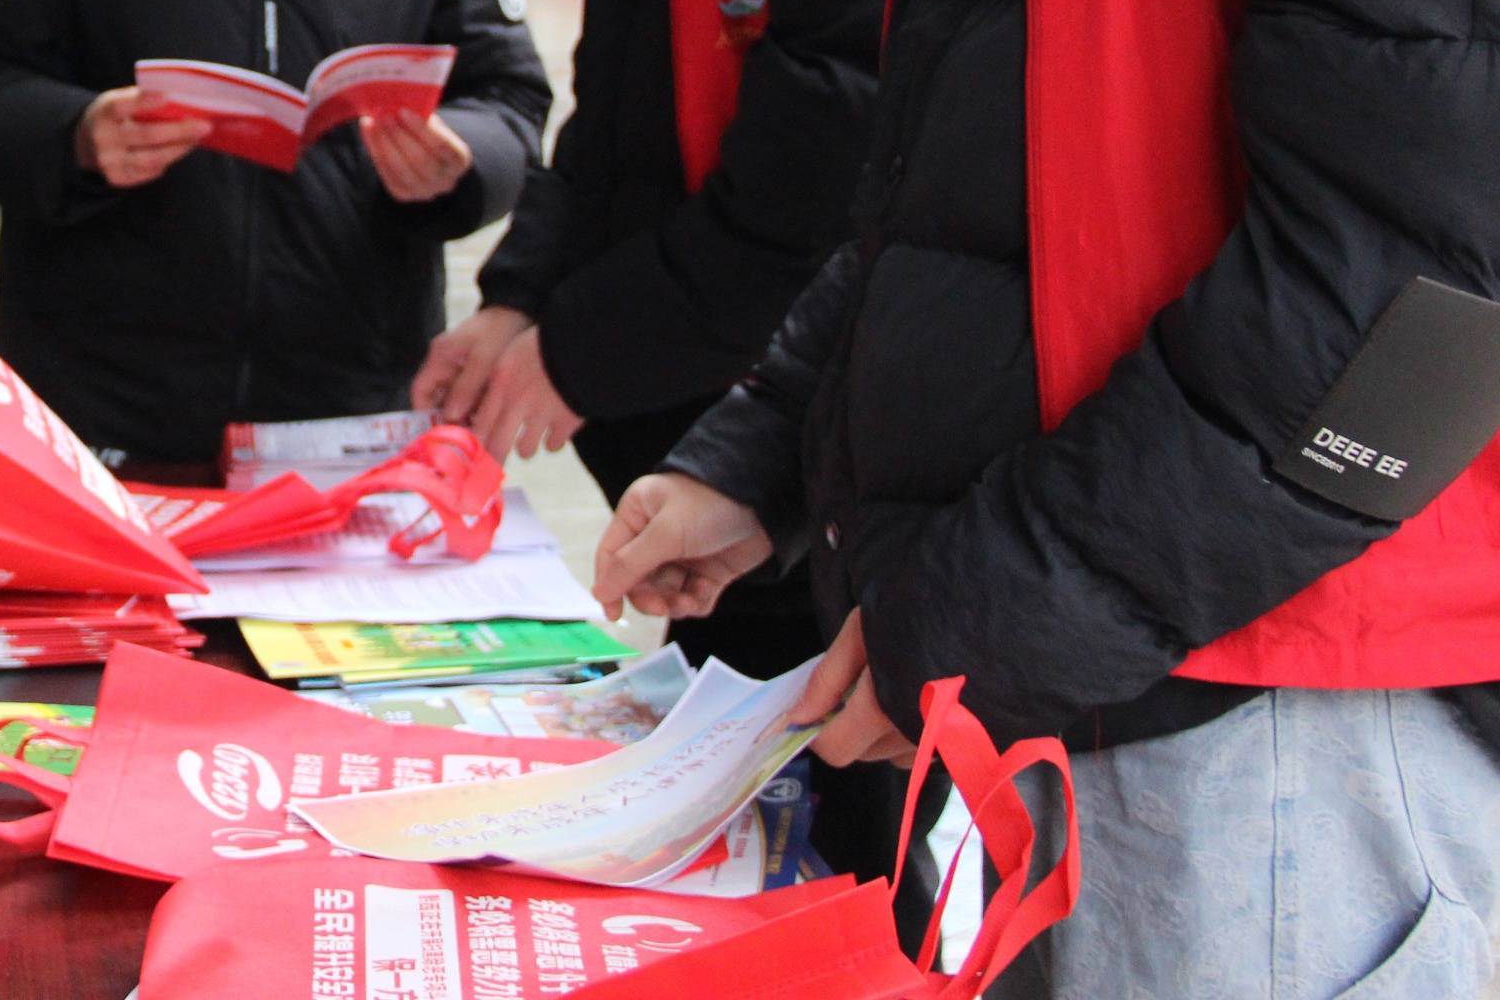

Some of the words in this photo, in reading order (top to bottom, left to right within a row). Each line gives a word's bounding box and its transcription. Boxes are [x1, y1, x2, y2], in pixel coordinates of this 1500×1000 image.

[1312, 427, 1378, 468] DEEE
[1374, 455, 1408, 479] EE
[212, 749, 250, 811] 12340
